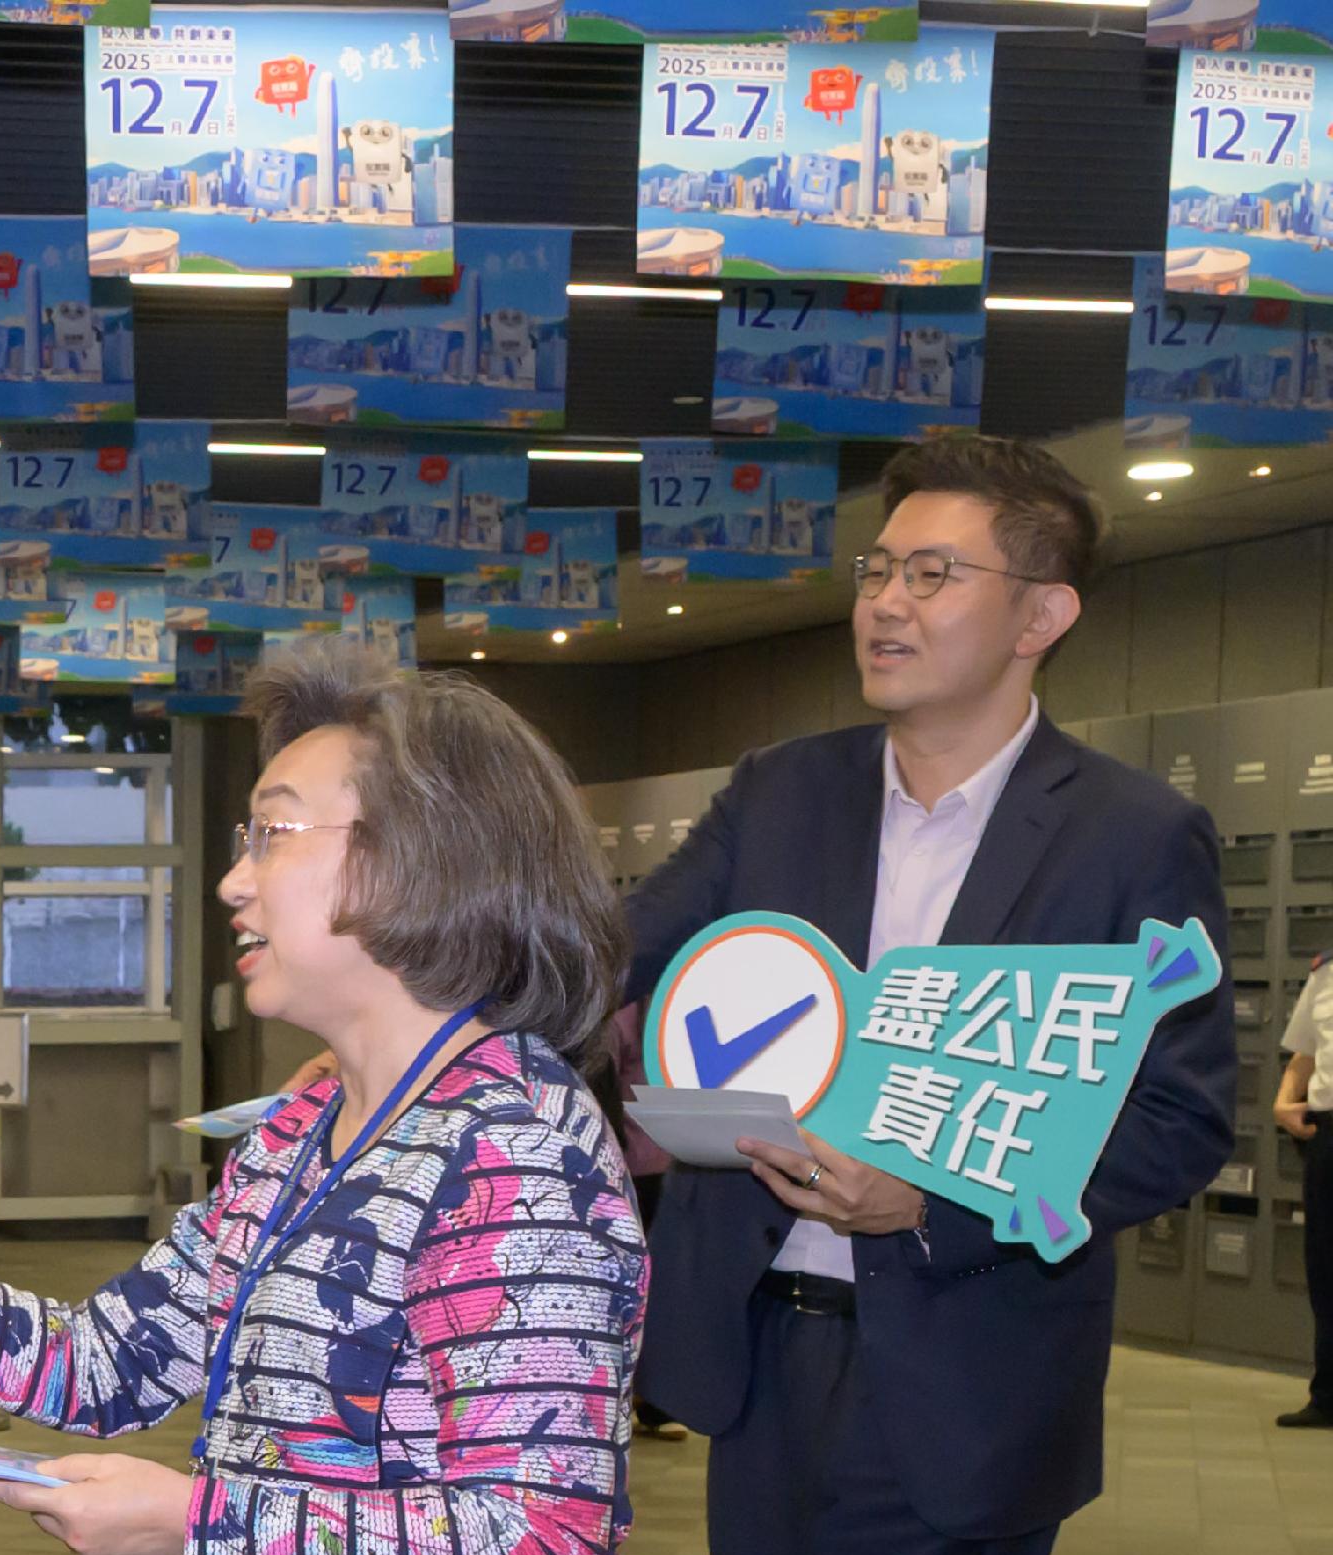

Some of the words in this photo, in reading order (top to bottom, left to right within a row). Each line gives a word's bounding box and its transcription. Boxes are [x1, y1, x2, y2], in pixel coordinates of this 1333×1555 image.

[101, 52, 150, 70] 2025
[659, 56, 706, 76] 2025
[1193, 82, 1238, 101] 2025
[856, 964, 1135, 1083] 盡公民
[861, 1062, 1050, 1194] 責任
